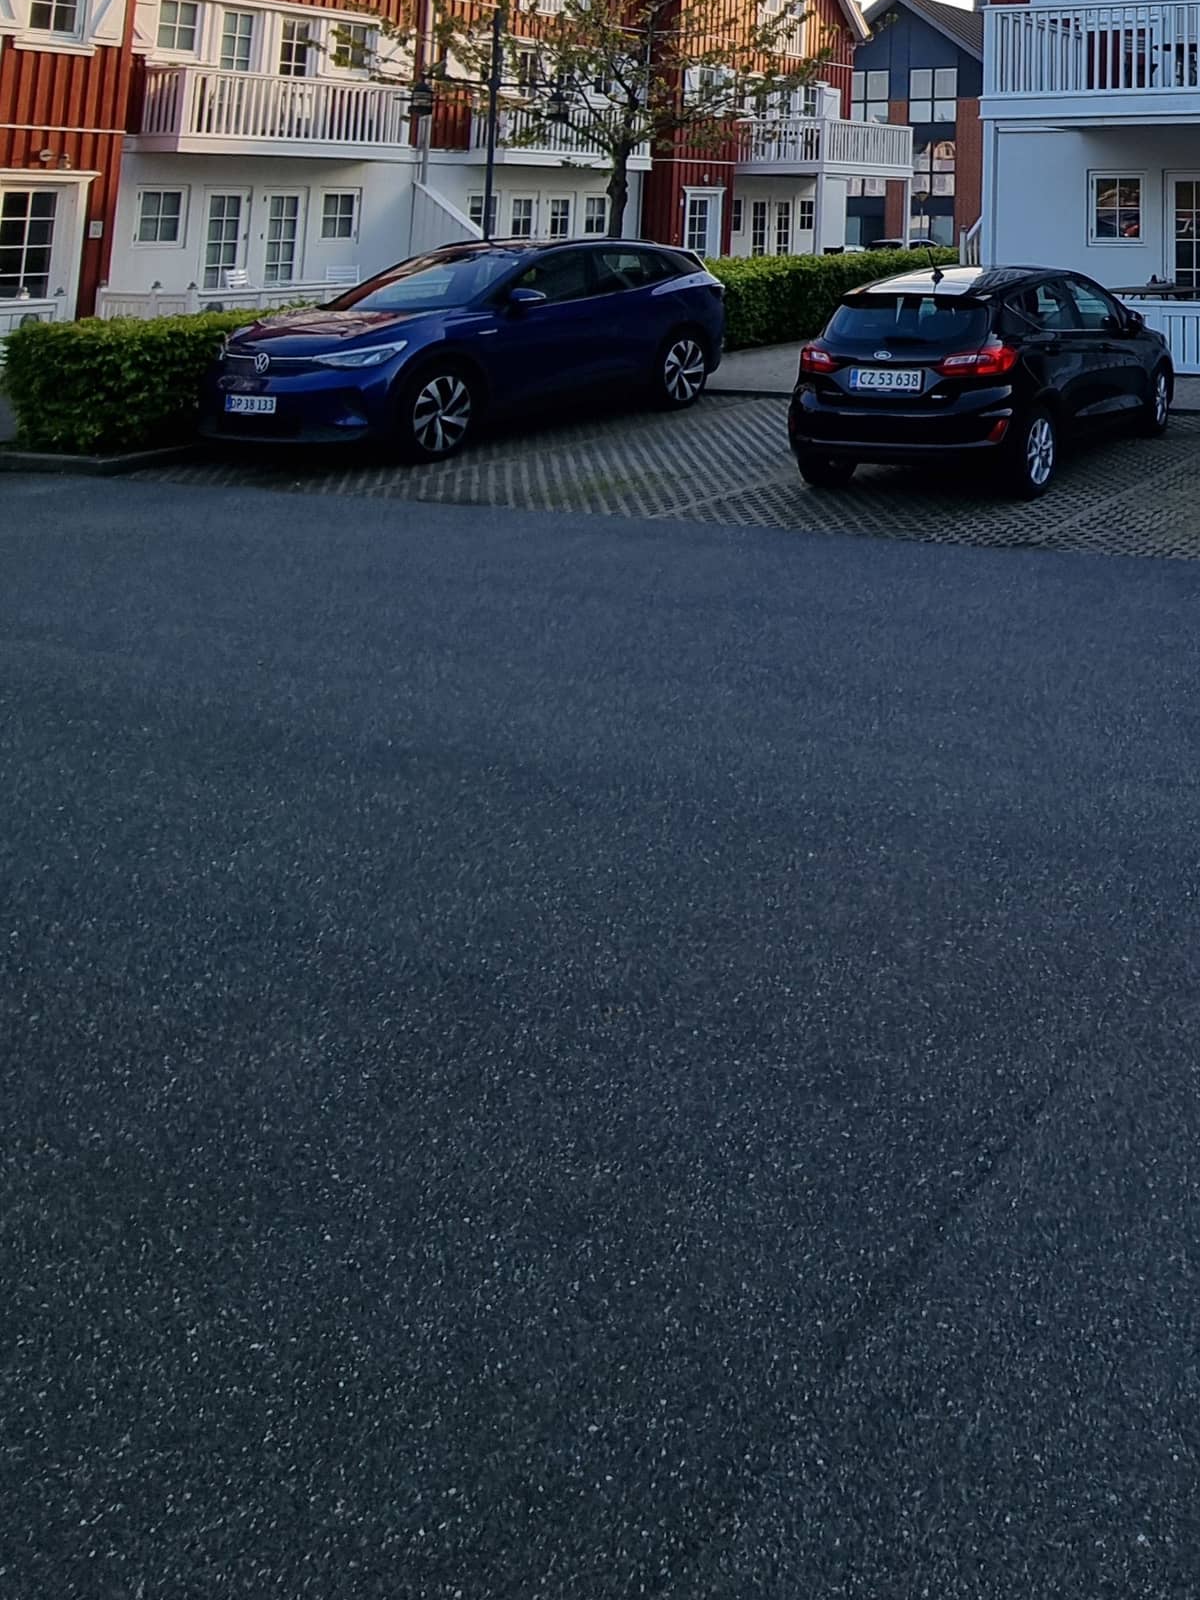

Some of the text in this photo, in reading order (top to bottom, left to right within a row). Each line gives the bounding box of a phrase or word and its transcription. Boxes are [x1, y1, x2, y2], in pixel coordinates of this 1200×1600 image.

[860, 372, 918, 386] CZ 53 638
